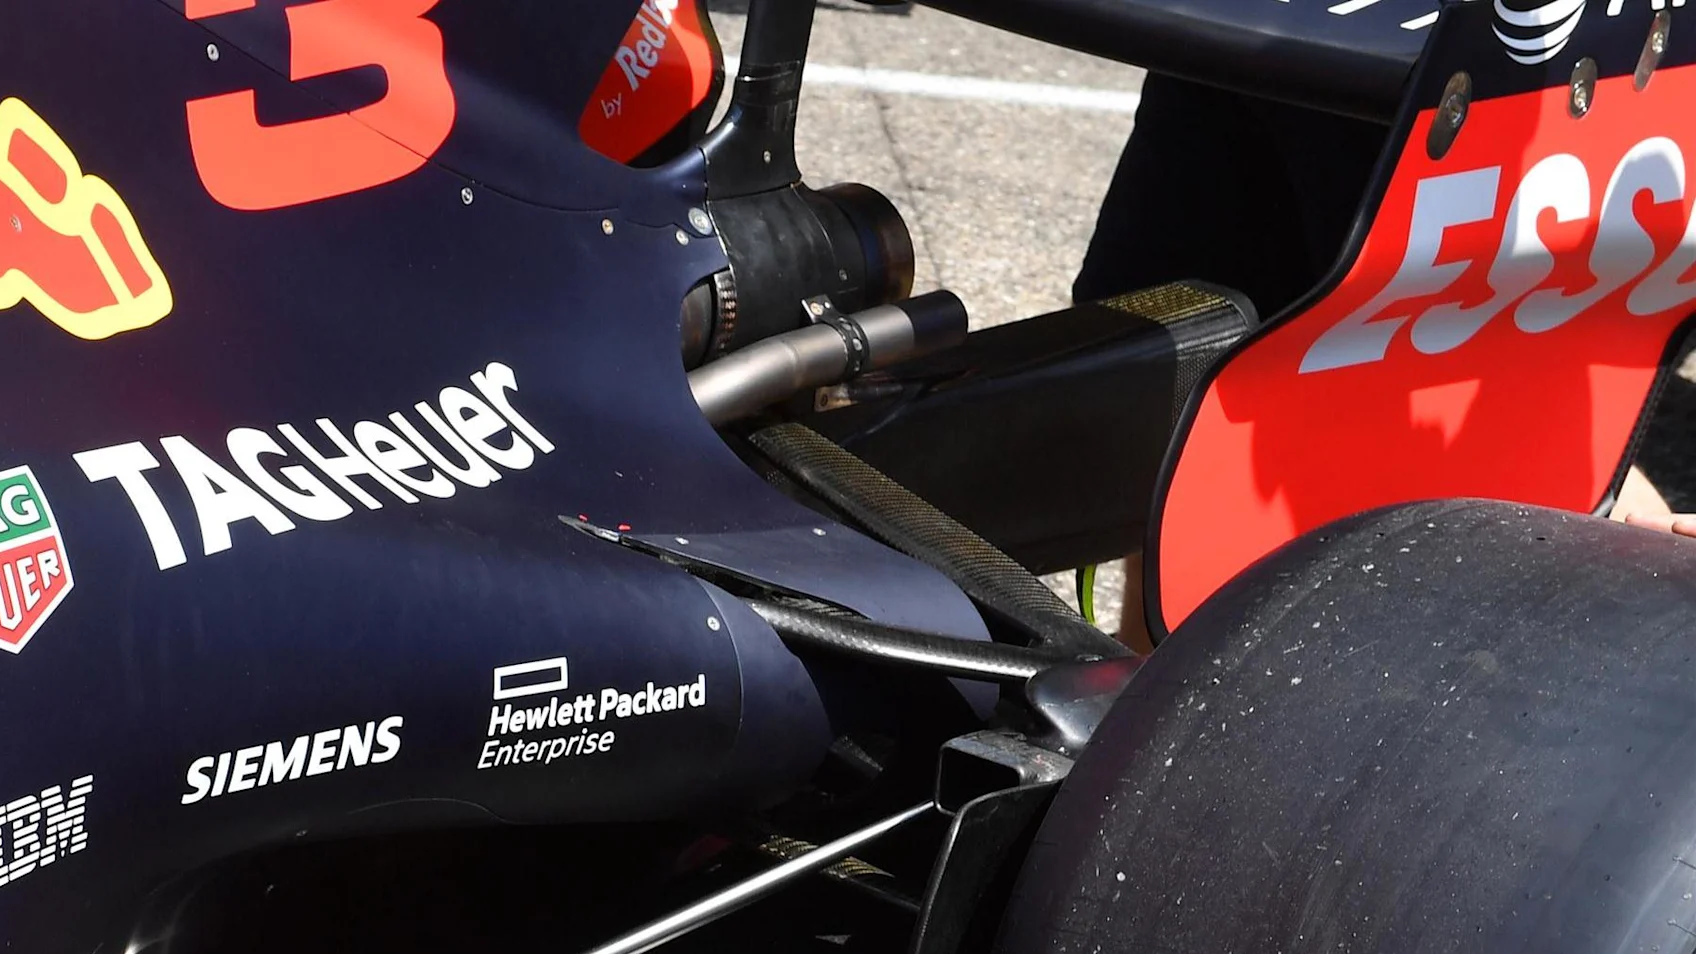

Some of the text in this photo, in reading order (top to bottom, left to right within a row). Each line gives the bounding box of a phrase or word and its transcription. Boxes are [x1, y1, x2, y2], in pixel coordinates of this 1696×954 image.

[601, 92, 622, 119] by
[487, 674, 706, 736] Hewlett Packard
[181, 715, 404, 805] SIEMENS
[477, 728, 616, 769] Enterprise
